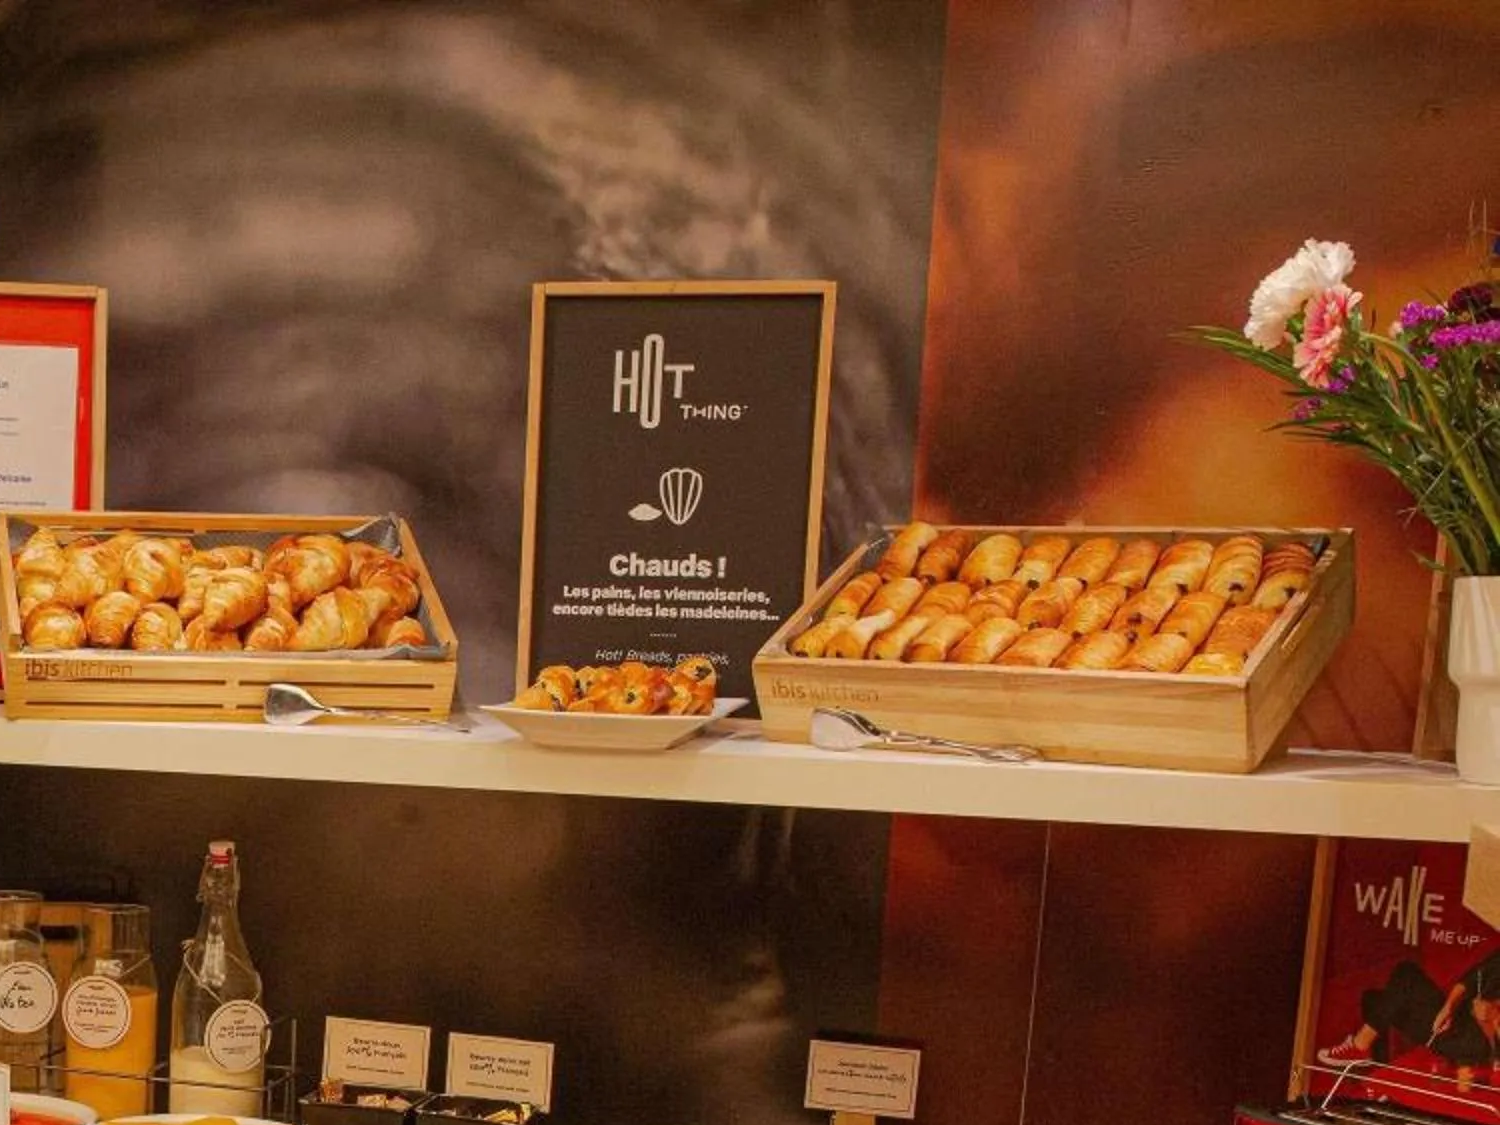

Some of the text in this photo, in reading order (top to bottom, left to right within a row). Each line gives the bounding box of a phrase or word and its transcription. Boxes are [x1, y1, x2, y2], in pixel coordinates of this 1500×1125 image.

[612, 332, 695, 430] HOT
[679, 403, 741, 421] THING
[609, 552, 727, 579] Chauds !
[563, 584, 772, 605] Les pains, les viennoiseries,
[552, 602, 781, 621] encore tièdes les madeleines...
[25, 658, 60, 677] ibis
[772, 679, 806, 700] ibis
[1354, 864, 1445, 947] WAKE
[1430, 928, 1455, 945] ME
